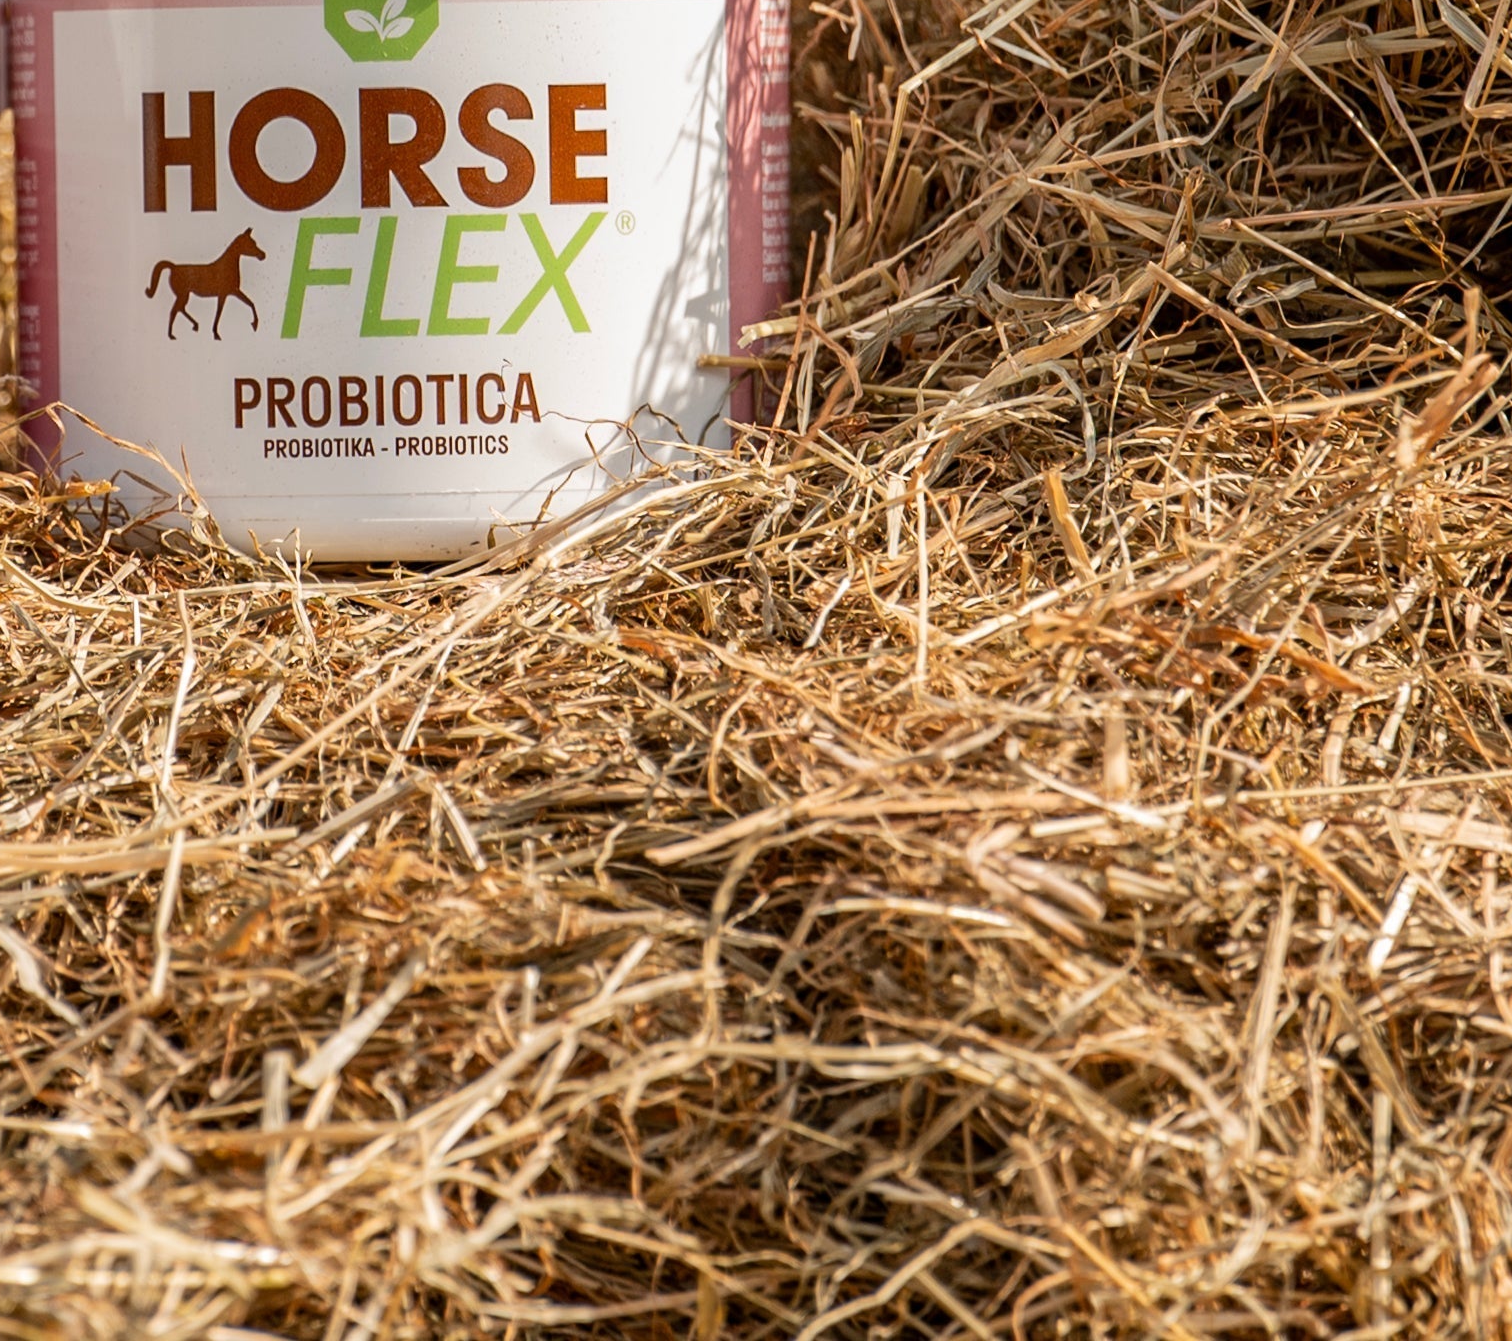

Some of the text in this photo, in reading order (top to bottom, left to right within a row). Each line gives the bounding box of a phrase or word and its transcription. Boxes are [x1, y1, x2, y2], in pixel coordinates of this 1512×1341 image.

[142, 83, 609, 213] HORSE
[280, 212, 609, 339] FLEX
[234, 373, 541, 428] PROBIOTICA
[264, 437, 375, 458] PROBIOTIKA
[395, 435, 509, 456] PROBIOTICS
